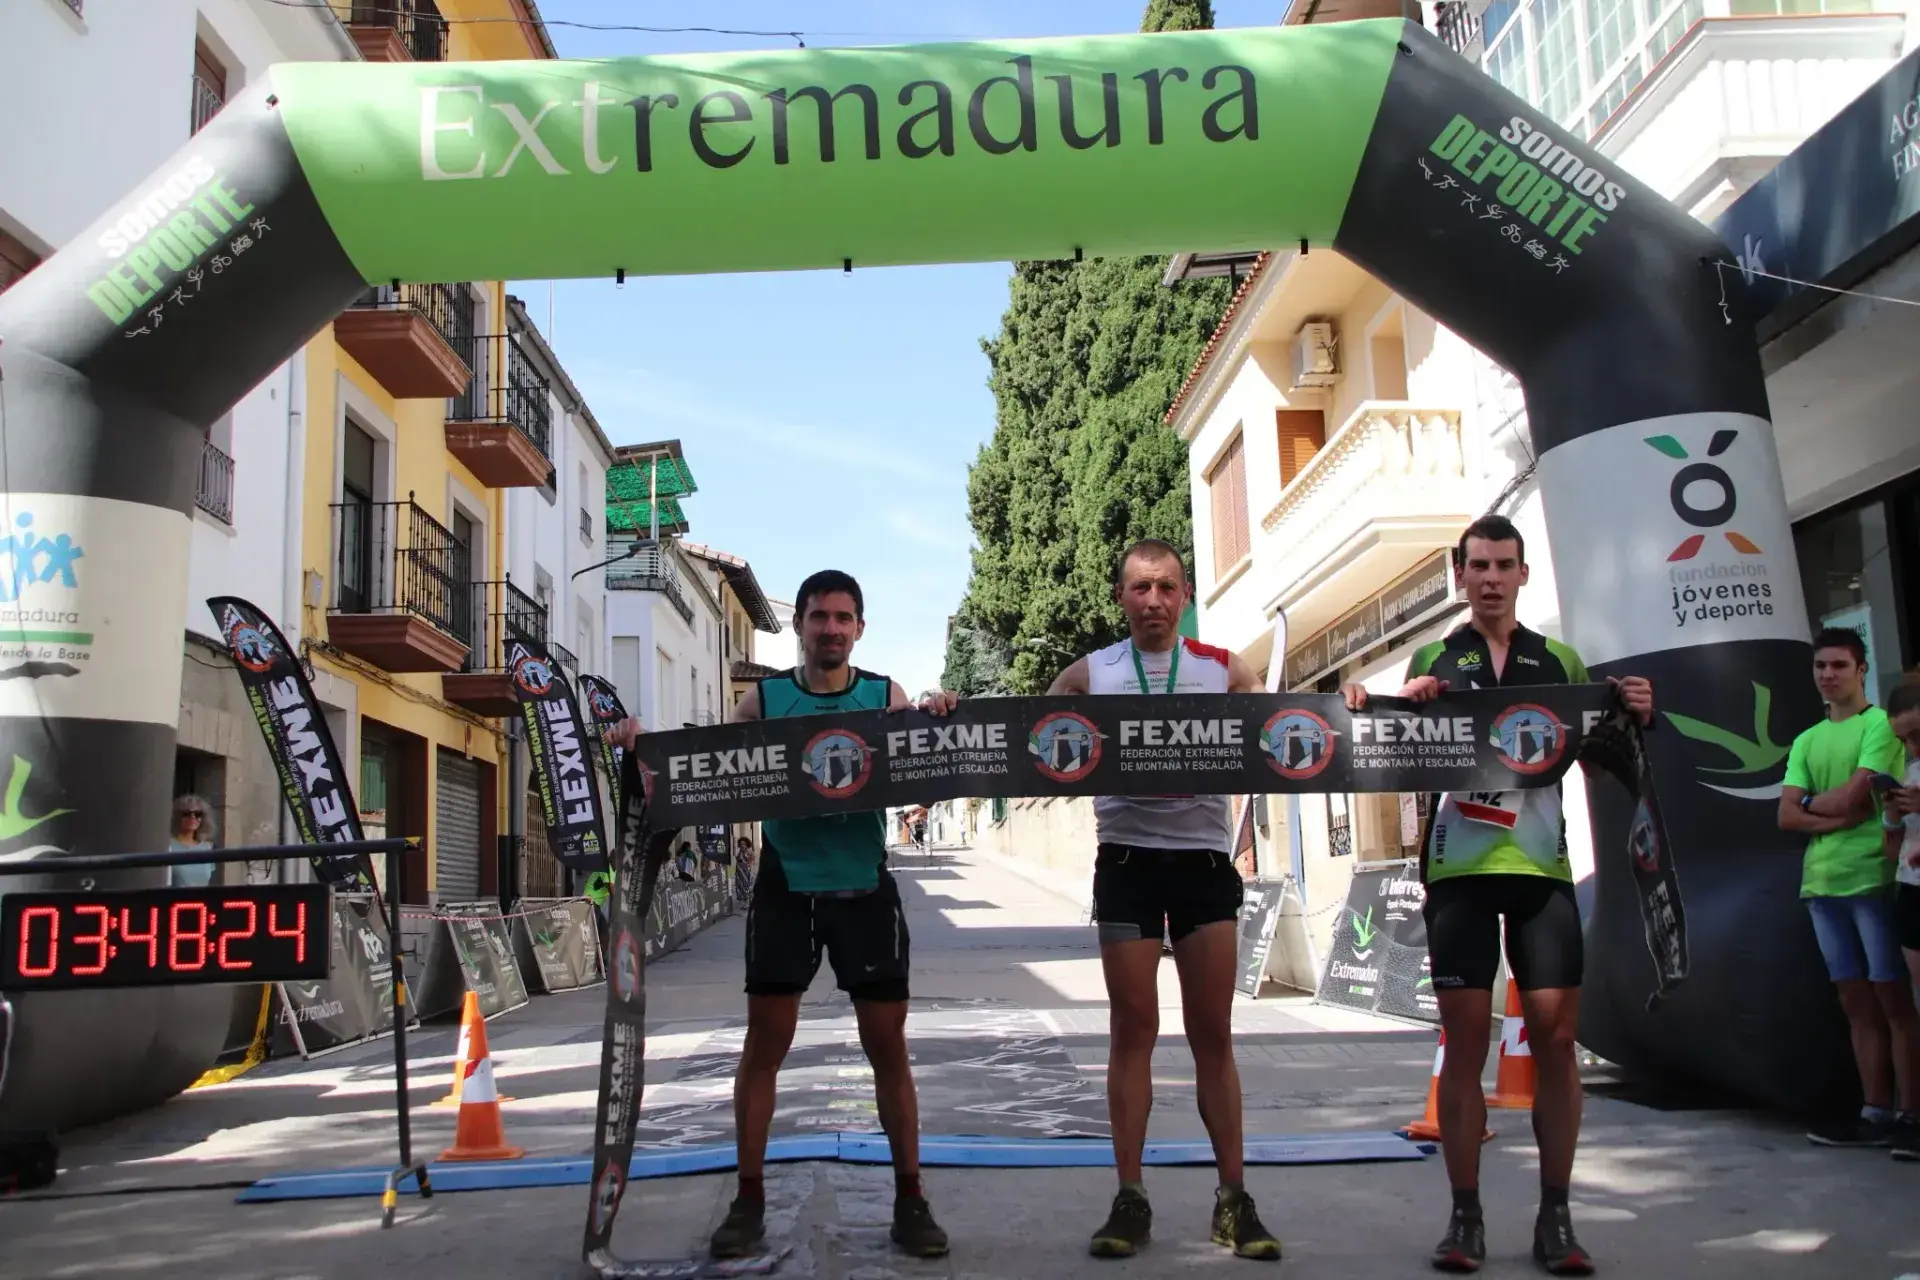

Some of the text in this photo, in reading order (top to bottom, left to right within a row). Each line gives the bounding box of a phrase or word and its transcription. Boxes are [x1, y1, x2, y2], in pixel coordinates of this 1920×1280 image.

[419, 55, 1259, 181] Extremadura
[1429, 114, 1609, 255] DEPORTE
[86, 177, 255, 326] DEPORTE
[1670, 560, 1767, 584] fundación
[1672, 582, 1772, 609] jóvenes
[1675, 600, 1774, 627] y deporte
[58, 647, 91, 660] Base
[887, 723, 1008, 757] FEXME
[1119, 718, 1244, 746] FEXME
[1351, 716, 1475, 743] FEXME
[669, 744, 788, 780] FEXME
[889, 750, 1008, 769] FEDERACIÓN EXTREMEÑA
[1120, 746, 1244, 759] FEDERACIÓN EXTREMEÑA
[1353, 743, 1476, 756] FEDERACIÓN EXTREMEÑA
[1353, 757, 1477, 768] DE MONTAÑA Y ESCALADA
[733, 771, 789, 787] EXTREMEÑA
[890, 763, 1008, 782] DE MONTAÑA Y ESCALADA
[1120, 760, 1244, 771] DE MONTAÑA Y ESCALADA
[671, 785, 790, 804] DE MONTAÑA Y ESCALADA
[18, 901, 306, 976] 03:48:24
[604, 1023, 625, 1145] FEXME
